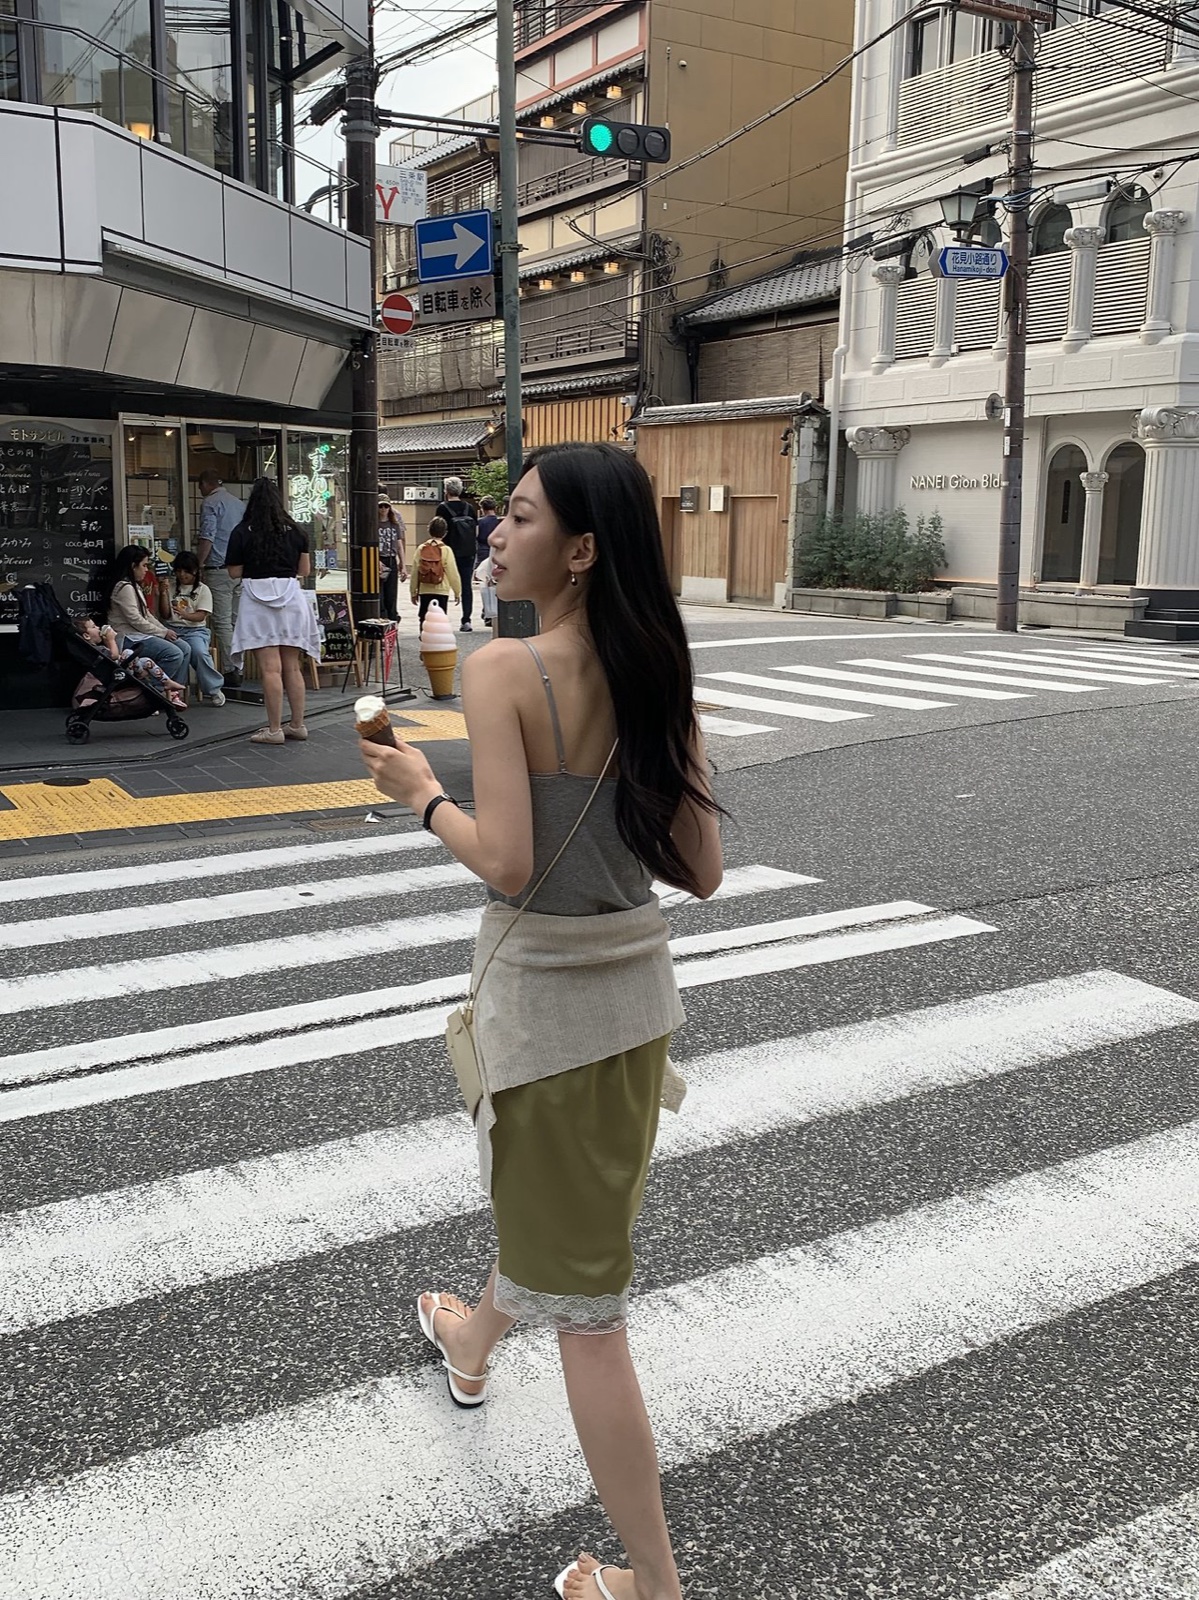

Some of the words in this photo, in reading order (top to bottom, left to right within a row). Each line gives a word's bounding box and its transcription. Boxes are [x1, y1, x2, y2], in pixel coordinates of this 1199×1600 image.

[951, 251, 997, 266] 花見小路通り
[952, 265, 997, 275] Hanamikoji-dori
[422, 285, 493, 315] 自転車を除く
[381, 336, 414, 349] 自転車を除く
[909, 475, 945, 489] NANEI
[949, 474, 978, 489] Gion
[981, 473, 1002, 490] Bld
[73, 557, 107, 565] P-stone
